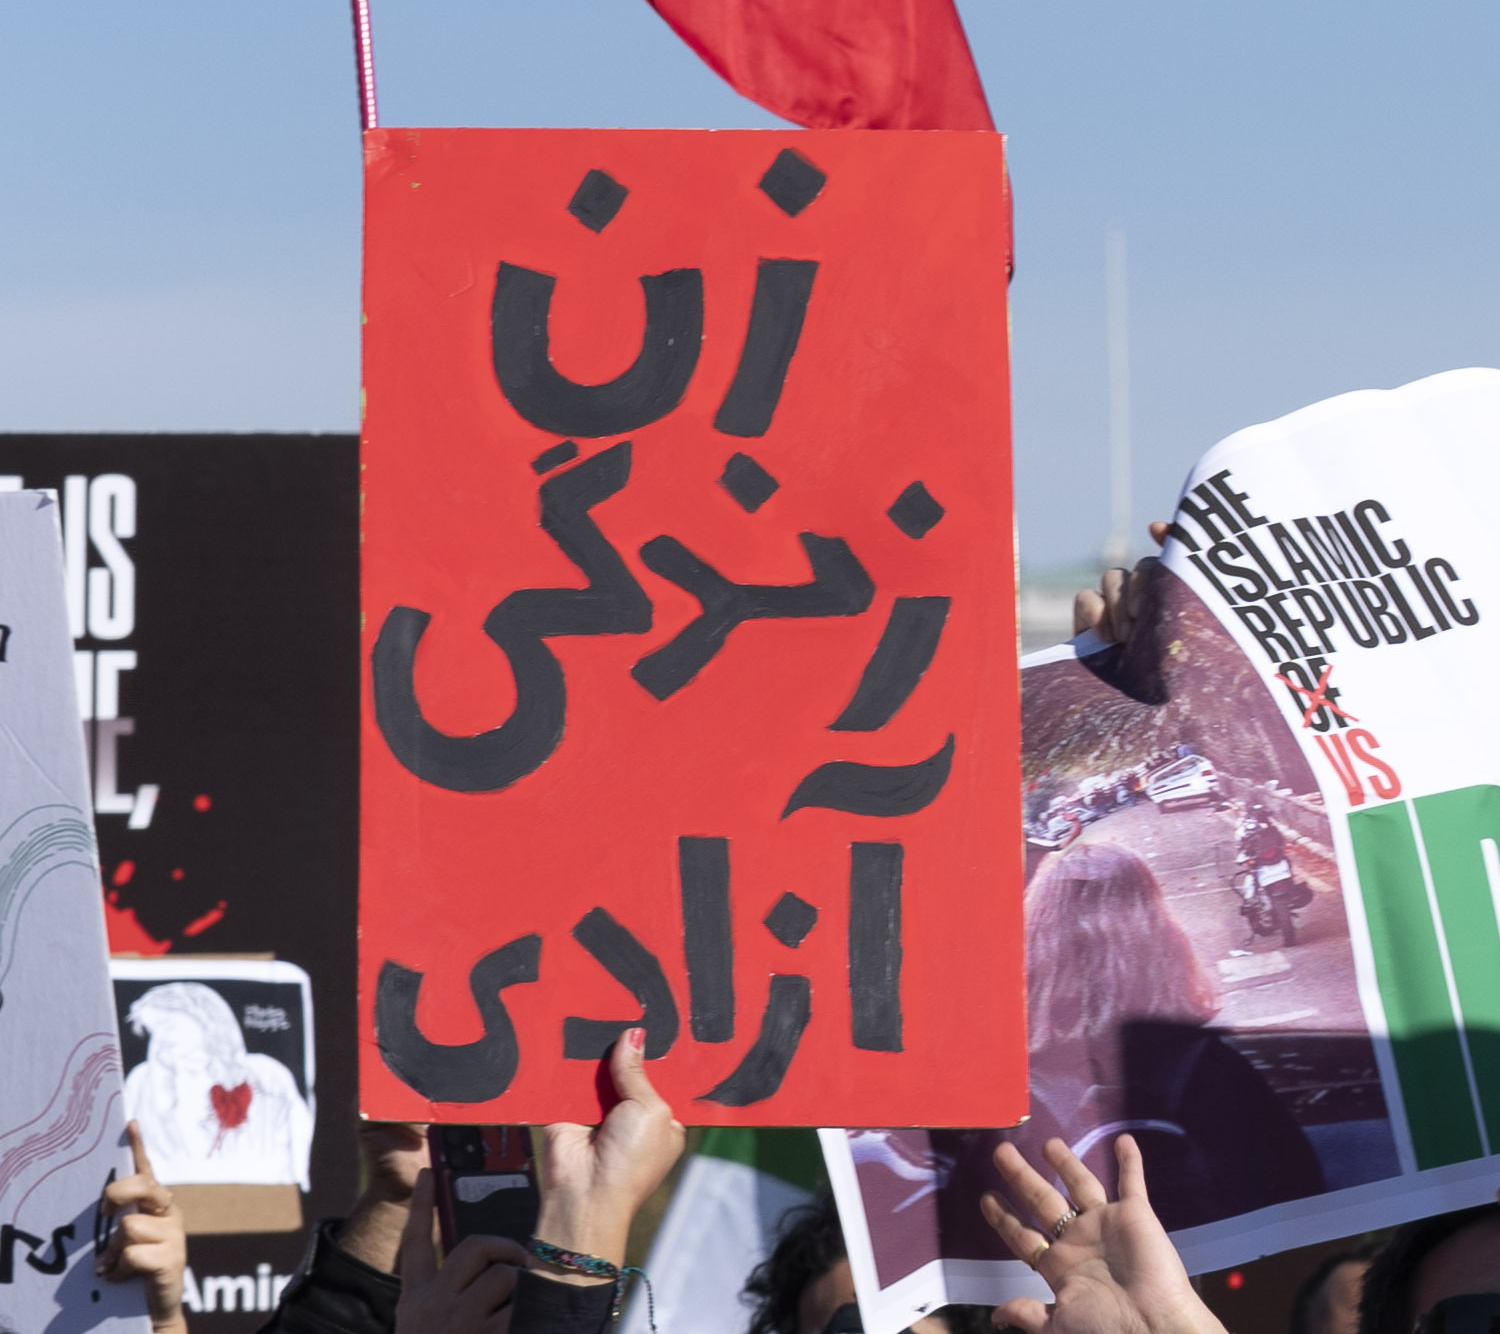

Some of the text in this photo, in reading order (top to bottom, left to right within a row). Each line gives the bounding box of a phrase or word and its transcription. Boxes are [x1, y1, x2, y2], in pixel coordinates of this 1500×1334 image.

[490, 147, 827, 439] زن
[1187, 499, 1412, 605] ISLAMIC
[1231, 557, 1480, 663] REPUBLIC
[1278, 656, 1350, 732] OF
[1313, 728, 1402, 806] VS
[373, 731, 957, 1108] آزادی
